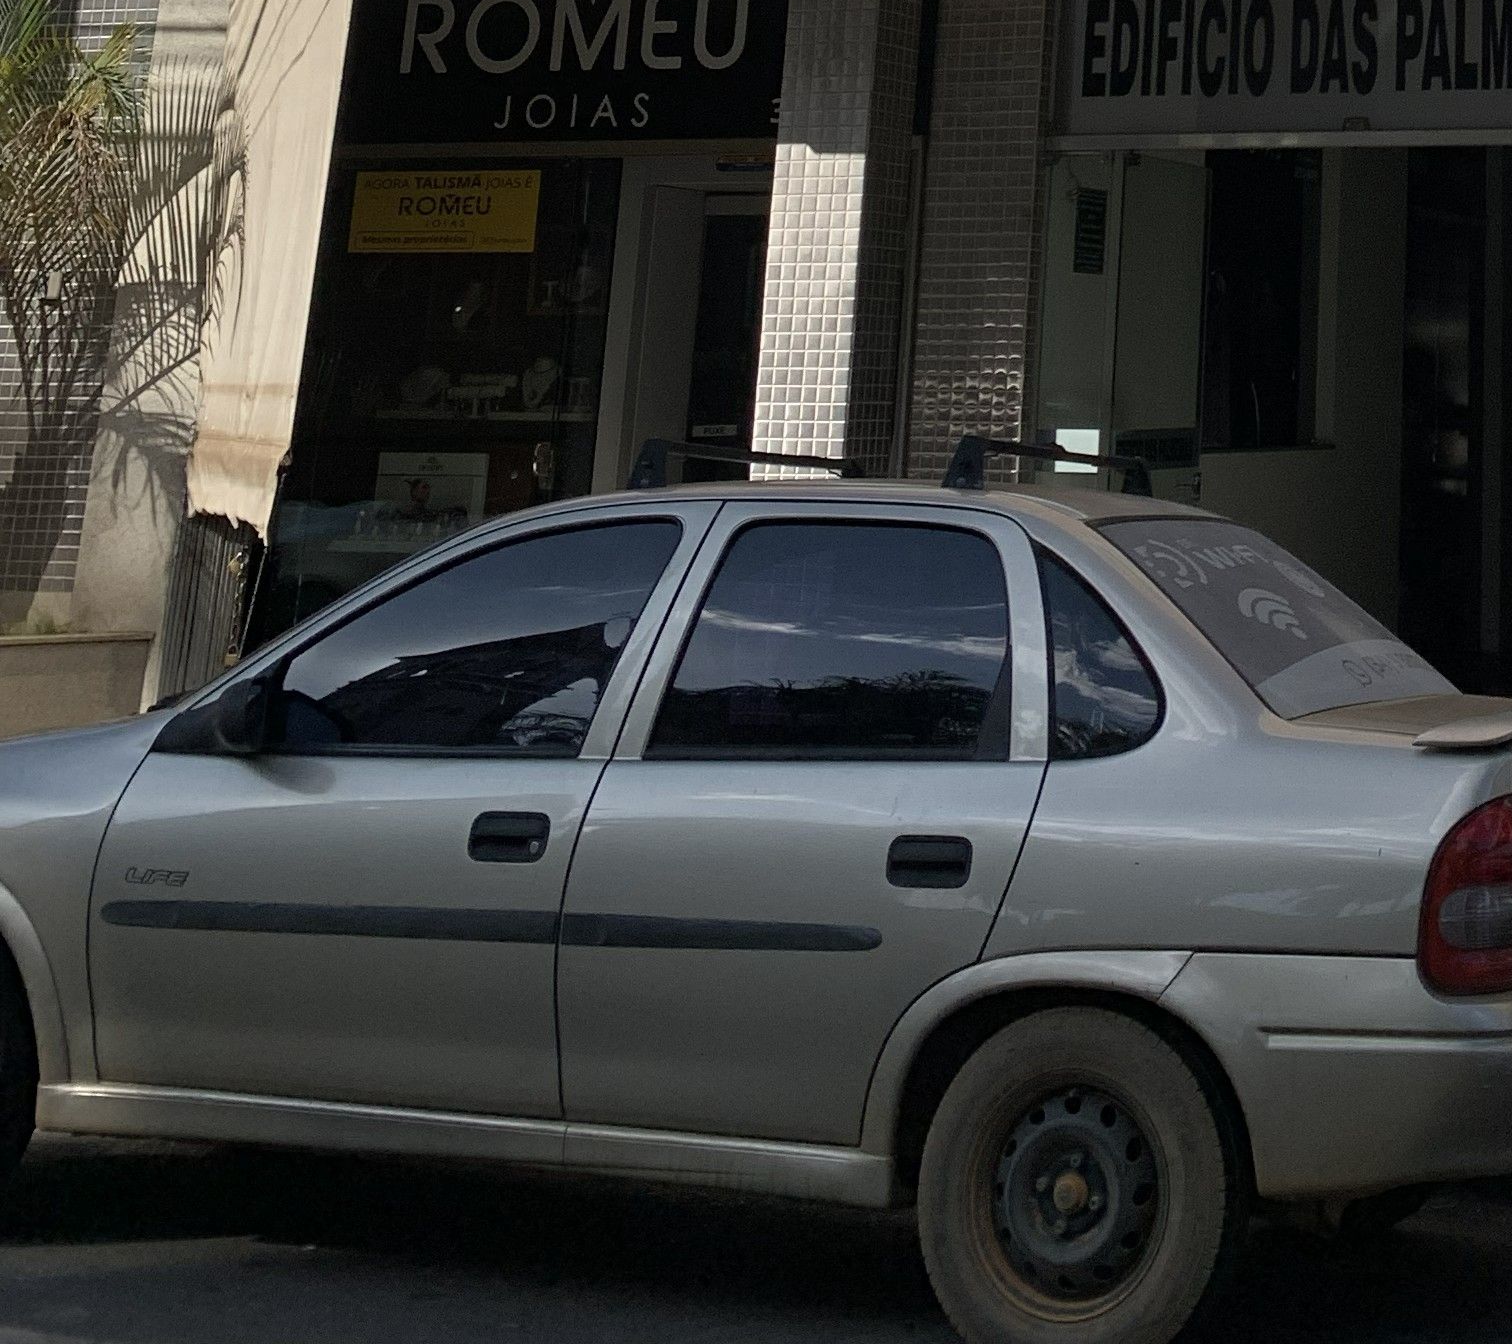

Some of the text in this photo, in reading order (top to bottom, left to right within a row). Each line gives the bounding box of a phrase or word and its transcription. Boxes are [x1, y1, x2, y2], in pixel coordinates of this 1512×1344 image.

[493, 92, 651, 130] JOIAS
[364, 177, 410, 189] AGORA
[484, 177, 522, 191] JOIAS
[397, 195, 492, 216] ROMEU
[125, 866, 190, 888] LIFE
